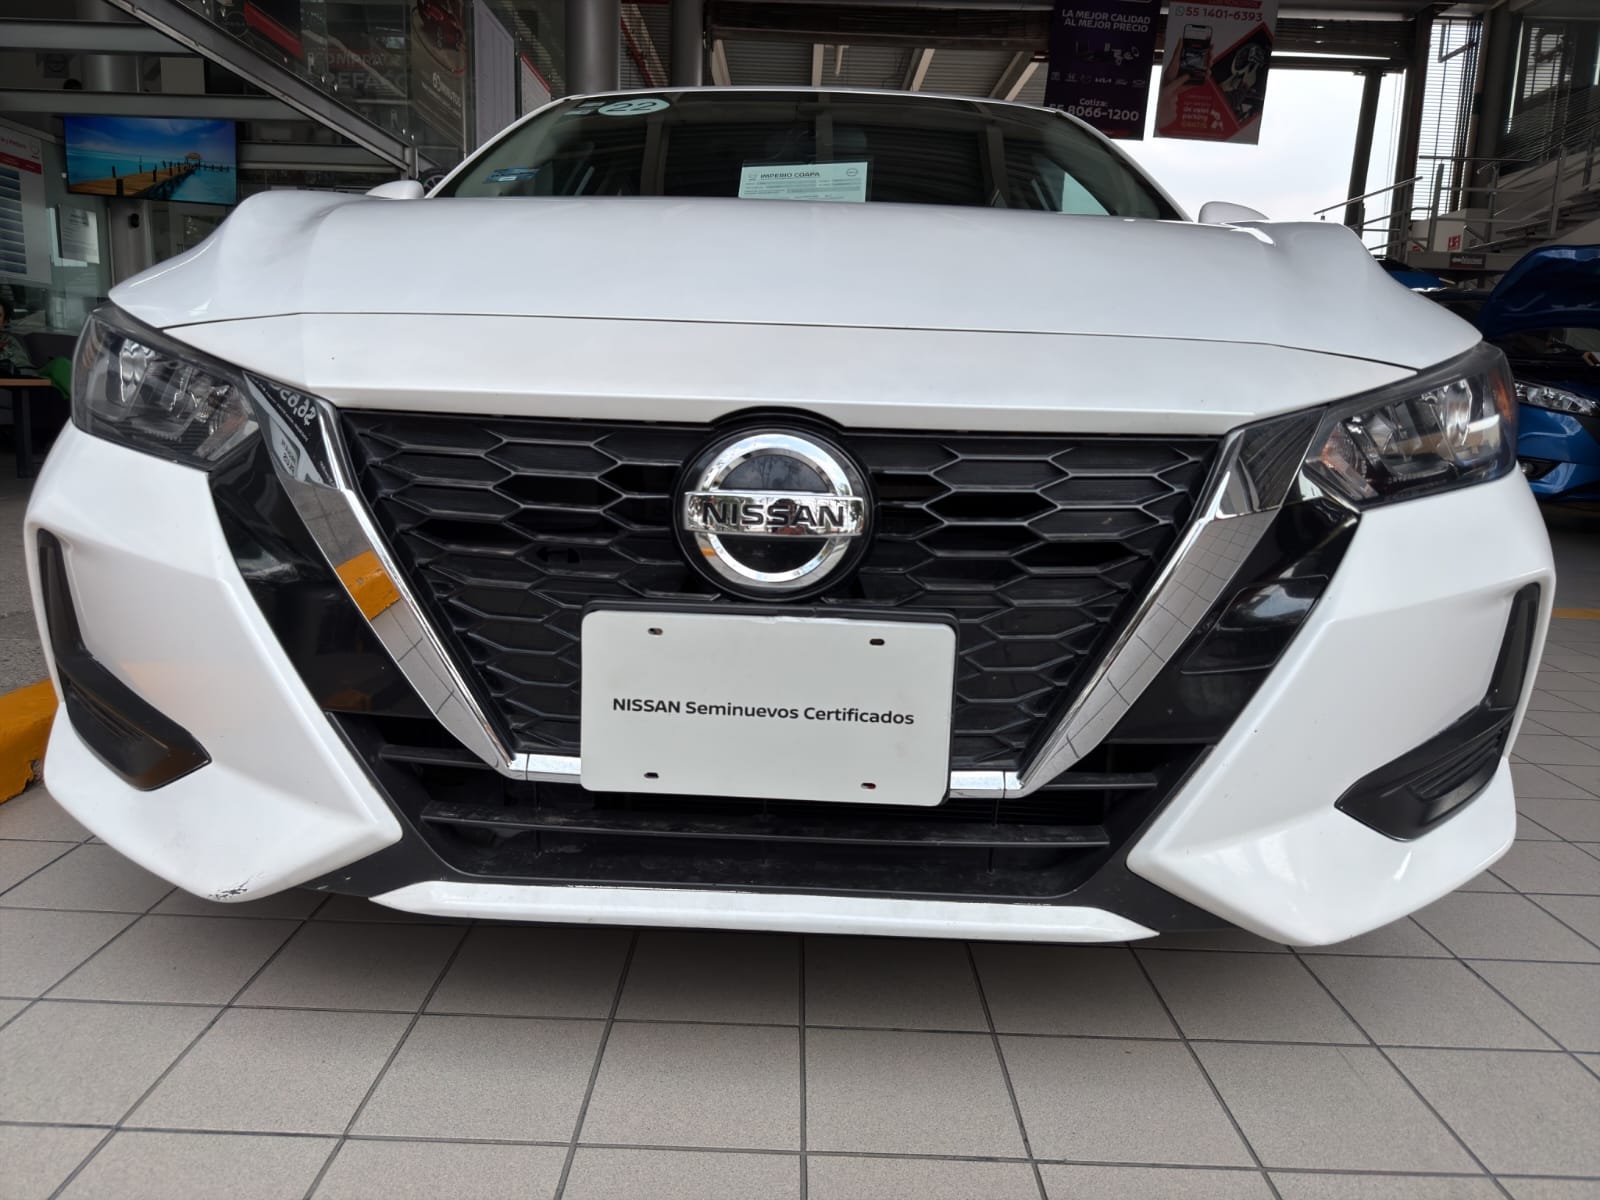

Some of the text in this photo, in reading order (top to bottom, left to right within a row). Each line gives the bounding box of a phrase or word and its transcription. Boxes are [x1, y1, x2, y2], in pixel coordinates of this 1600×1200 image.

[1062, 9, 1151, 24] LA MEJOR CALIDAD
[1185, 7, 1264, 22] 55 1401-6393
[1064, 18, 1149, 32] AL MEJOR PRECIO
[1079, 98, 1108, 107] Cotiza:
[1067, 105, 1140, 121] 8066-1200
[702, 502, 844, 527] NISSAN
[612, 698, 915, 725] NISSAN Seminuevos Certificados
